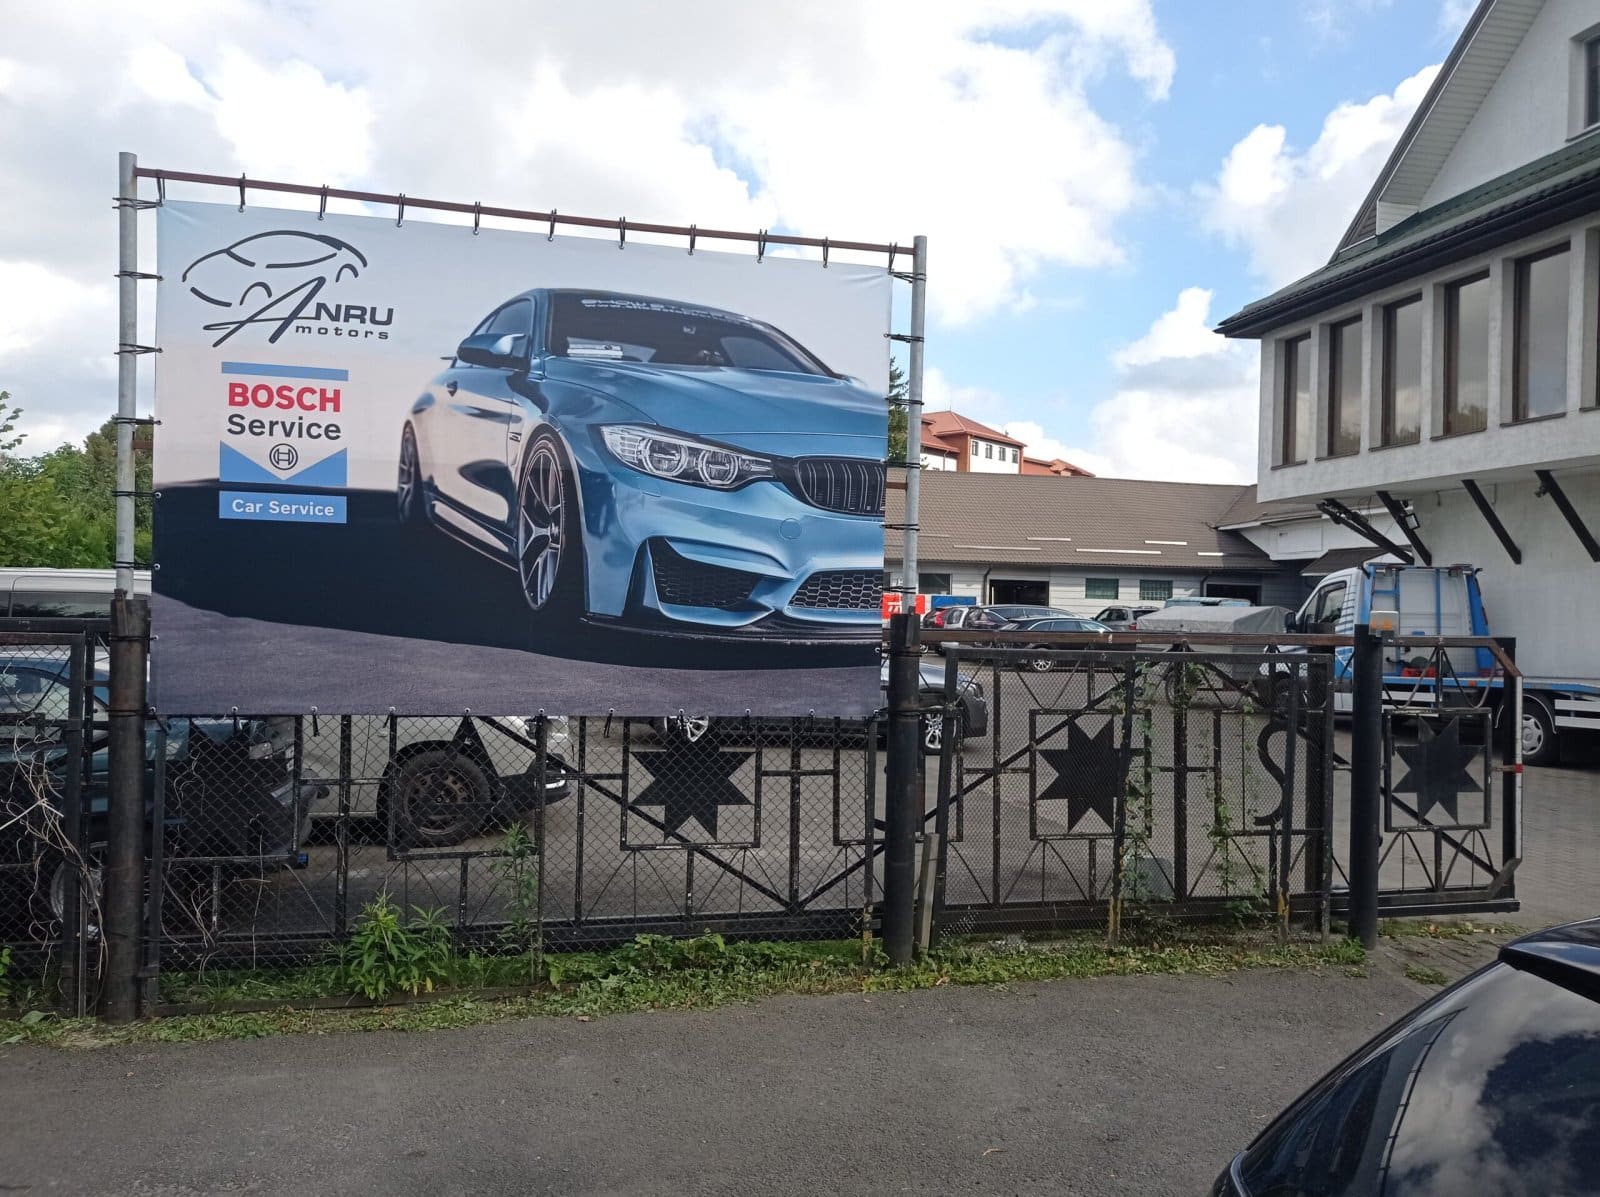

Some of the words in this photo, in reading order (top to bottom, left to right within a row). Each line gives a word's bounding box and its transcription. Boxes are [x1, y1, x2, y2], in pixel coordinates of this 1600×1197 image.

[203, 276, 394, 348] ANRU
[295, 325, 389, 340] motors
[228, 382, 341, 412] BOSCH
[227, 413, 341, 440] Service
[232, 499, 263, 513] Car
[269, 500, 334, 516] Service
